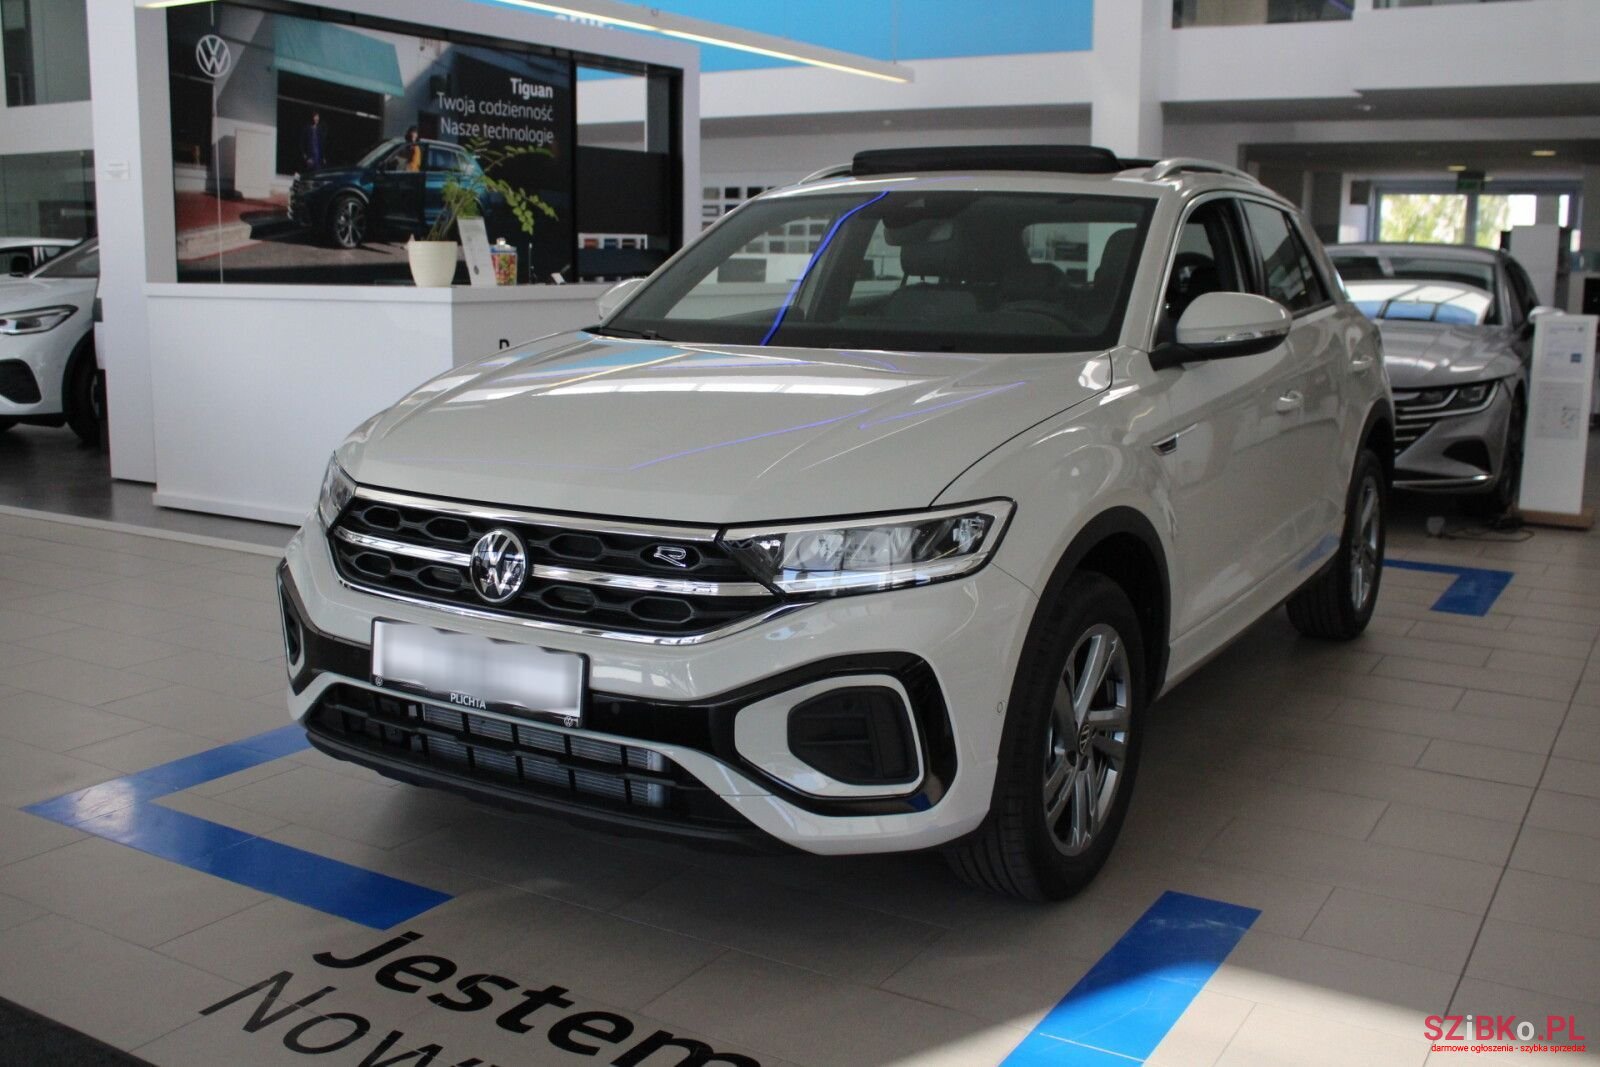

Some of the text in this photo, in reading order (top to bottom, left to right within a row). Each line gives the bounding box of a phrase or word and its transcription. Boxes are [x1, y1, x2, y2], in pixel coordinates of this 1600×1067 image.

[510, 77, 553, 100] Tiguan
[436, 91, 553, 121] Twoja codzienność
[440, 117, 554, 147] Nasze technologie
[450, 693, 487, 710] PLICHTA
[312, 930, 762, 1067] Jestem
[198, 970, 498, 1067] Now
